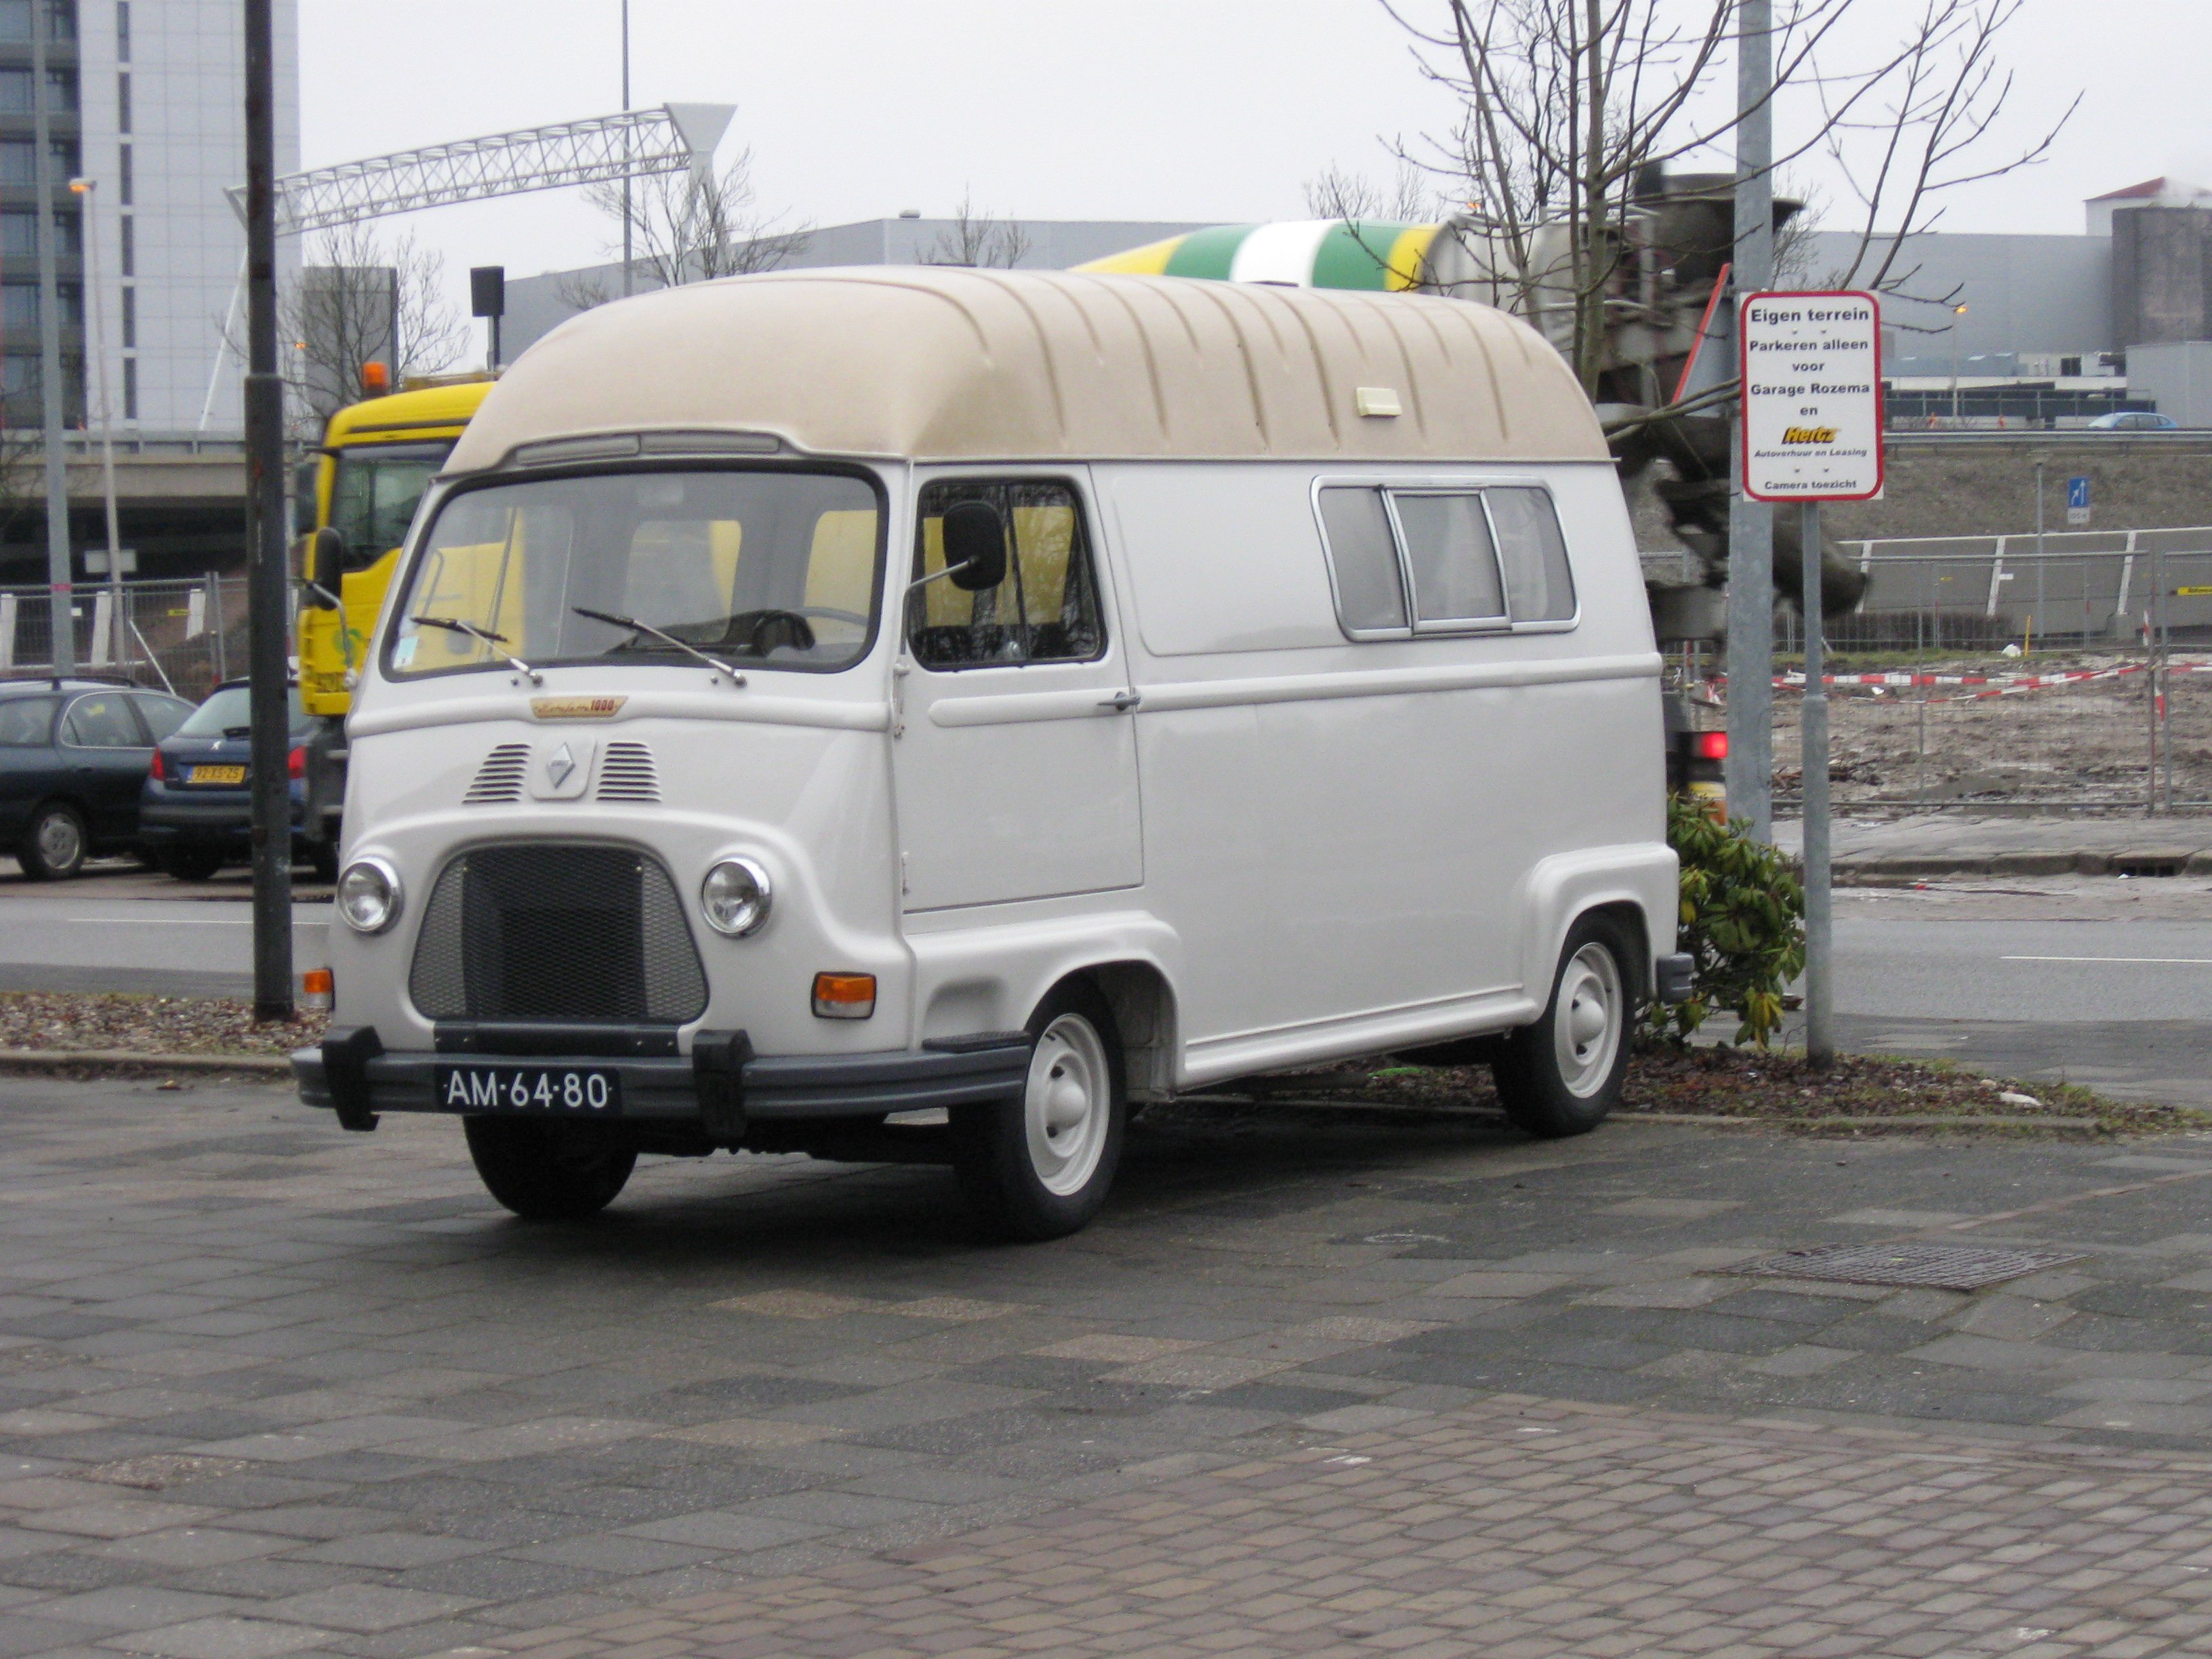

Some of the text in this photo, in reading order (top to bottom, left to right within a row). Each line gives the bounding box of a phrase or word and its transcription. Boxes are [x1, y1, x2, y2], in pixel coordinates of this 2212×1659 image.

[1750, 307, 1869, 325] Eigen terrein
[1749, 339, 1868, 352] Parkeren alleen
[1792, 362, 1825, 372] voor
[1750, 382, 1870, 397] Garage Rozema
[1799, 407, 1818, 416] en
[1781, 426, 1839, 445] Hertz
[1754, 449, 1813, 458] Autoverhuur
[1829, 448, 1868, 459] Leasing
[1764, 479, 1858, 490] Camera toezicht
[591, 699, 615, 711] 1000
[447, 1069, 609, 1109] AM-64-80
